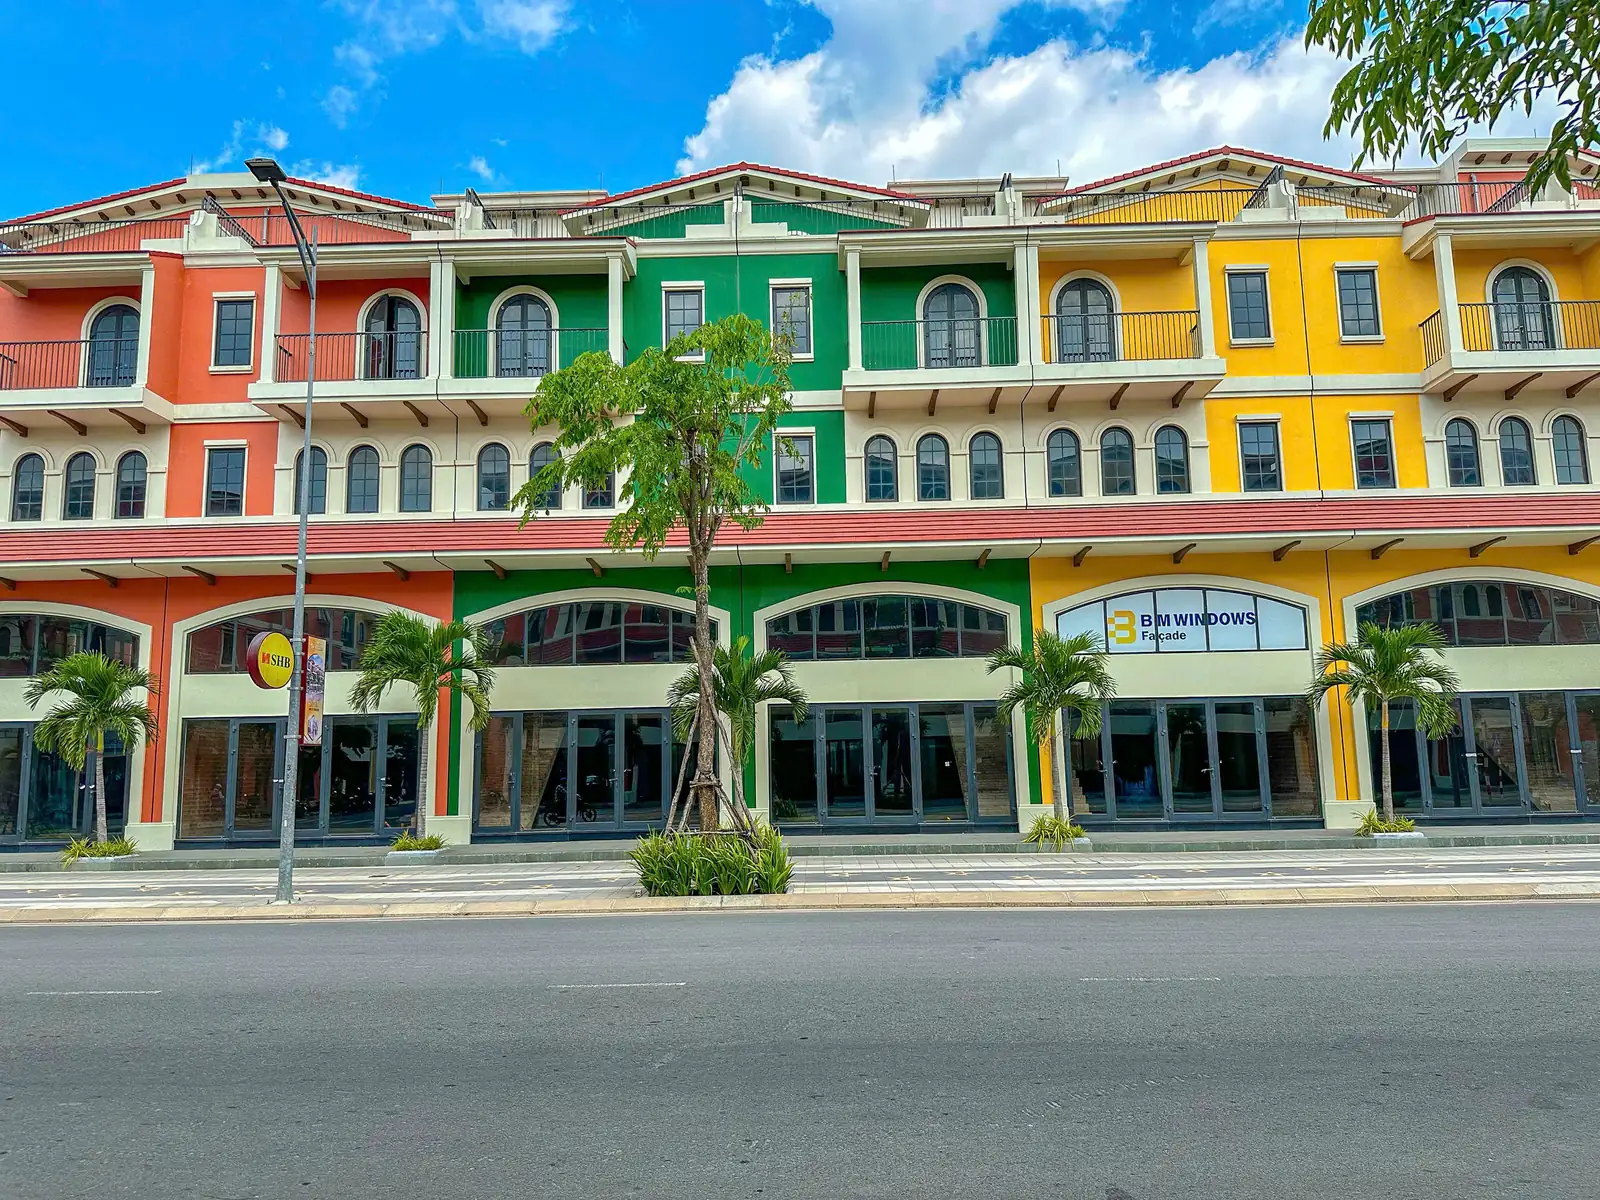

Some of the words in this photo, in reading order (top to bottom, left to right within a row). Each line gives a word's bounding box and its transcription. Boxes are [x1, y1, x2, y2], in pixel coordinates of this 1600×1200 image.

[1173, 611, 1257, 627] WINDOWS
[1141, 630, 1187, 643] Façade
[270, 654, 291, 669] SHB
